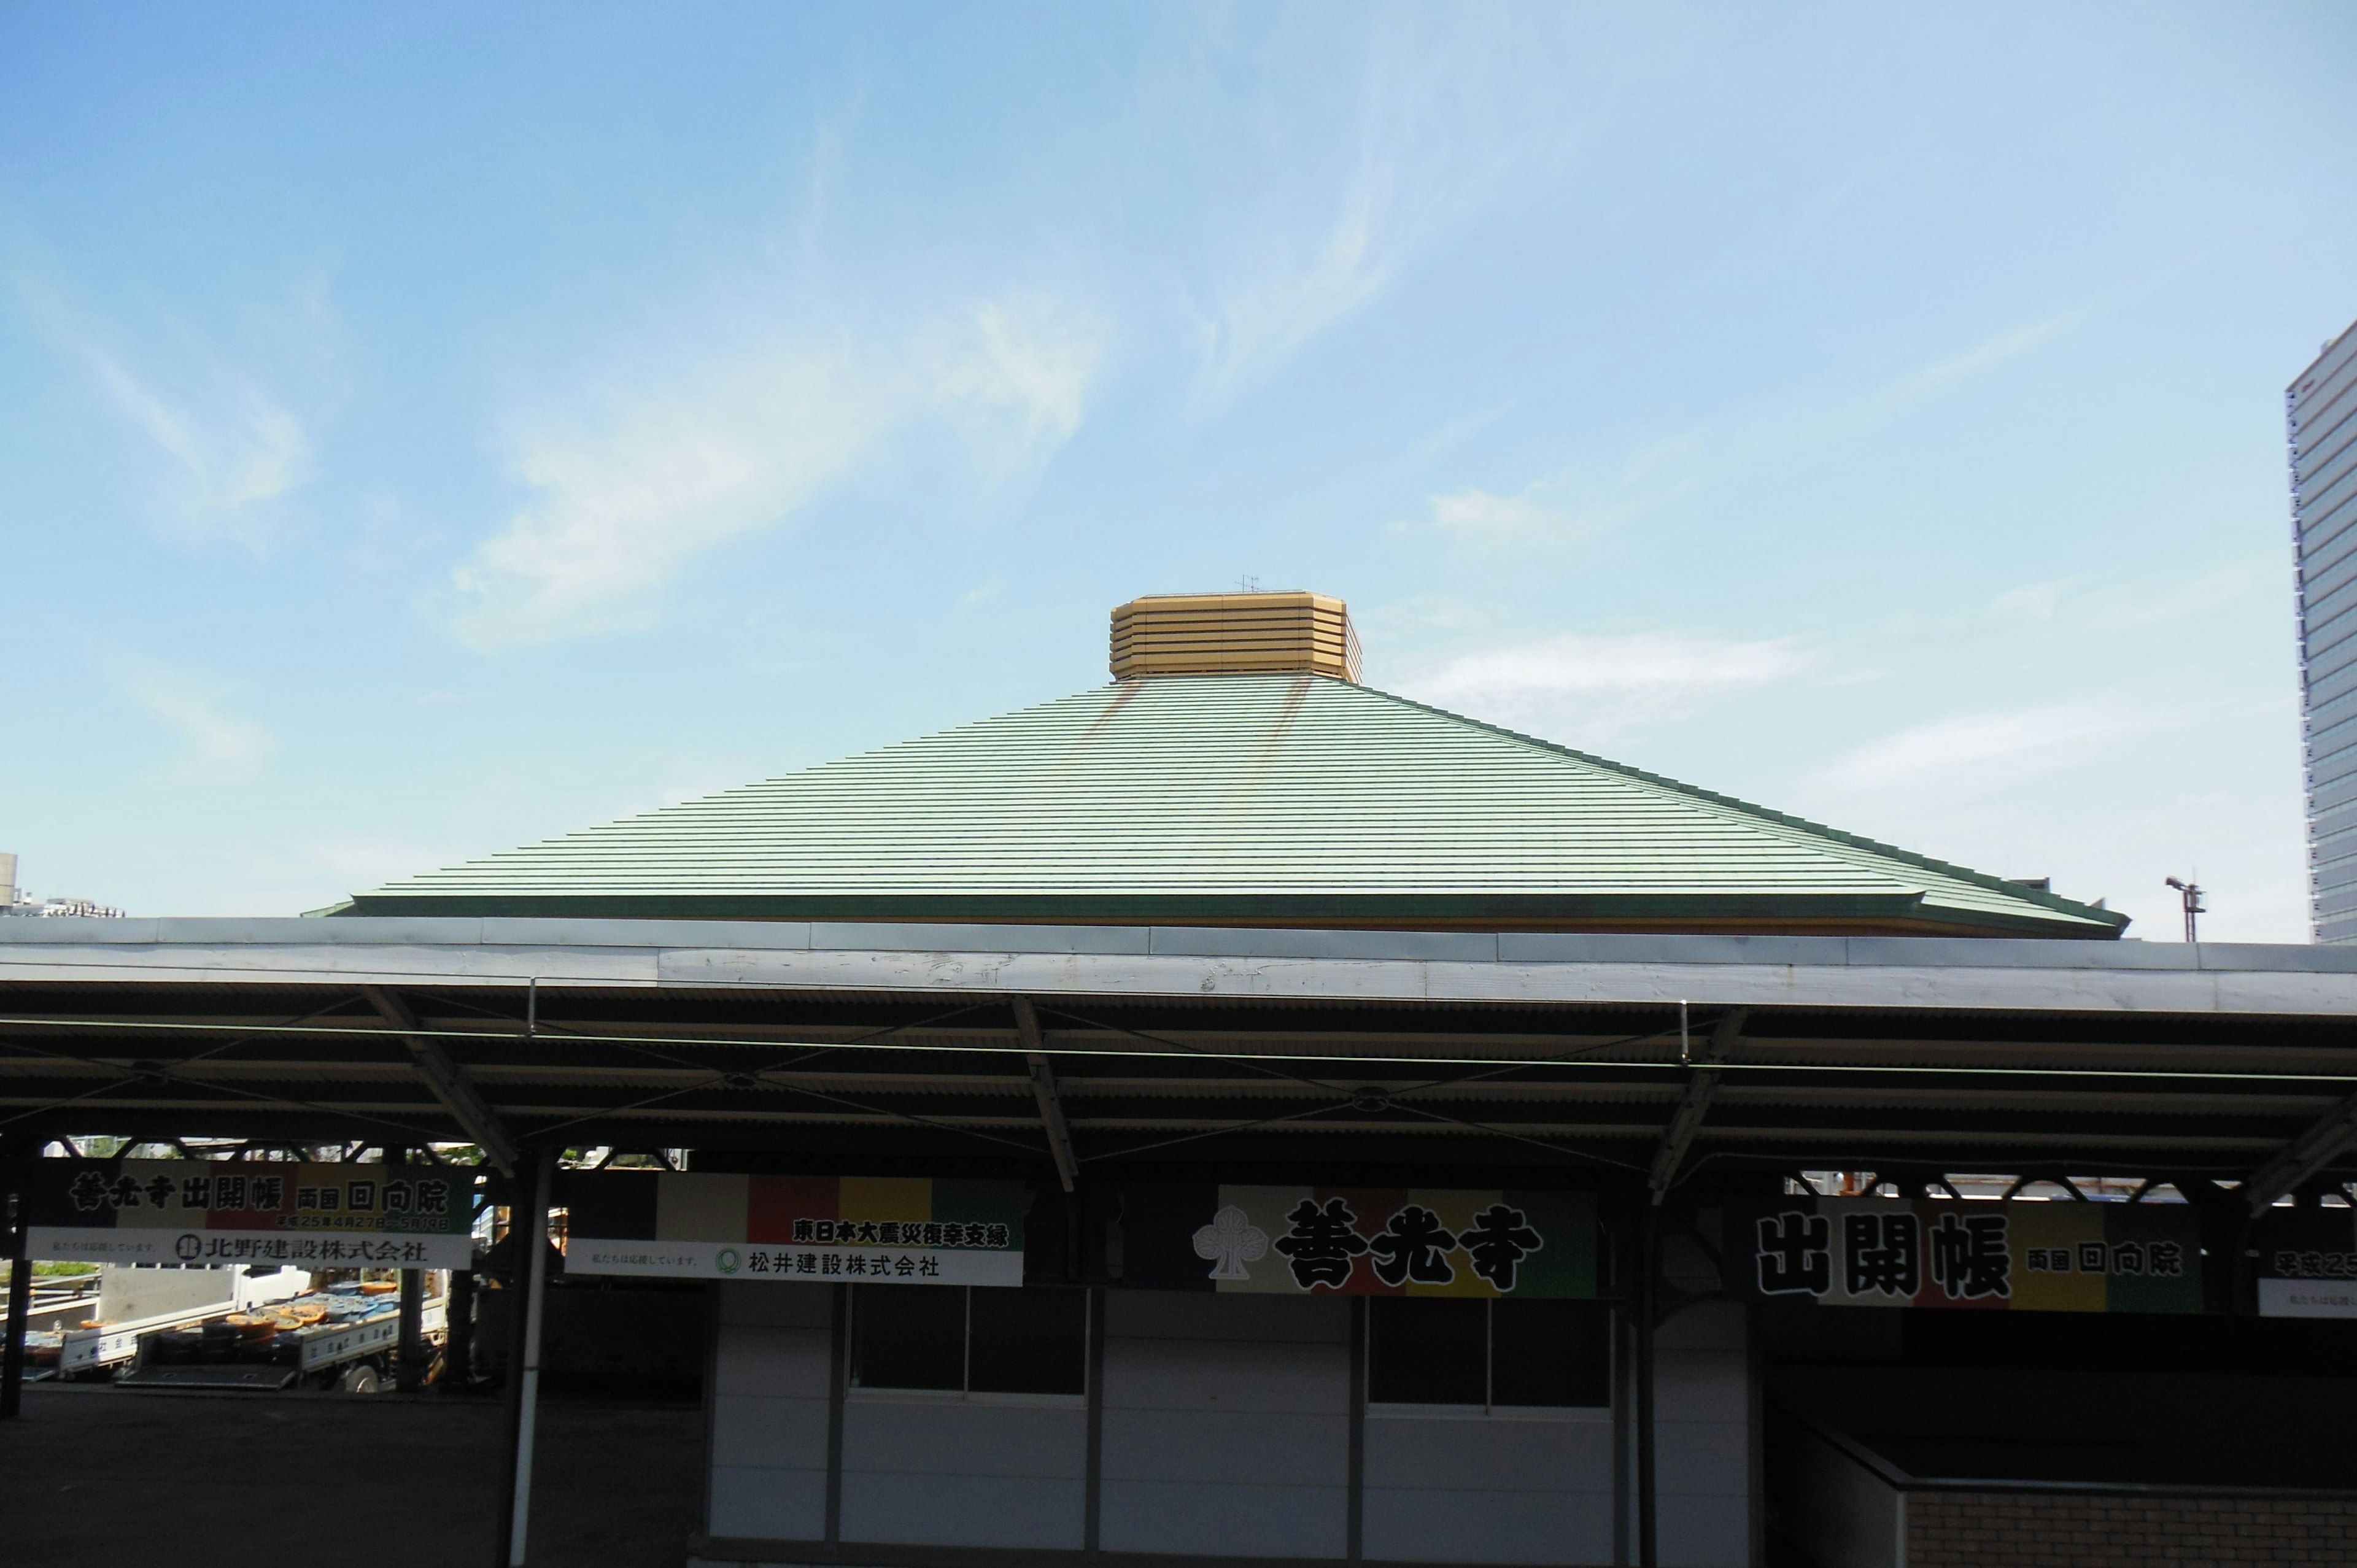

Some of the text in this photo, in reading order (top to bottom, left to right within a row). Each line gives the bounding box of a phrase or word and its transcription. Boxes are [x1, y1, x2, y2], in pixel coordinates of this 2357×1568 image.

[205, 1237, 428, 1261] 北野建設株式会社
[749, 1252, 940, 1276] 松井建設株式会社
[1275, 1197, 1543, 1292] 善光寺
[1756, 1210, 2012, 1300] 出開帳
